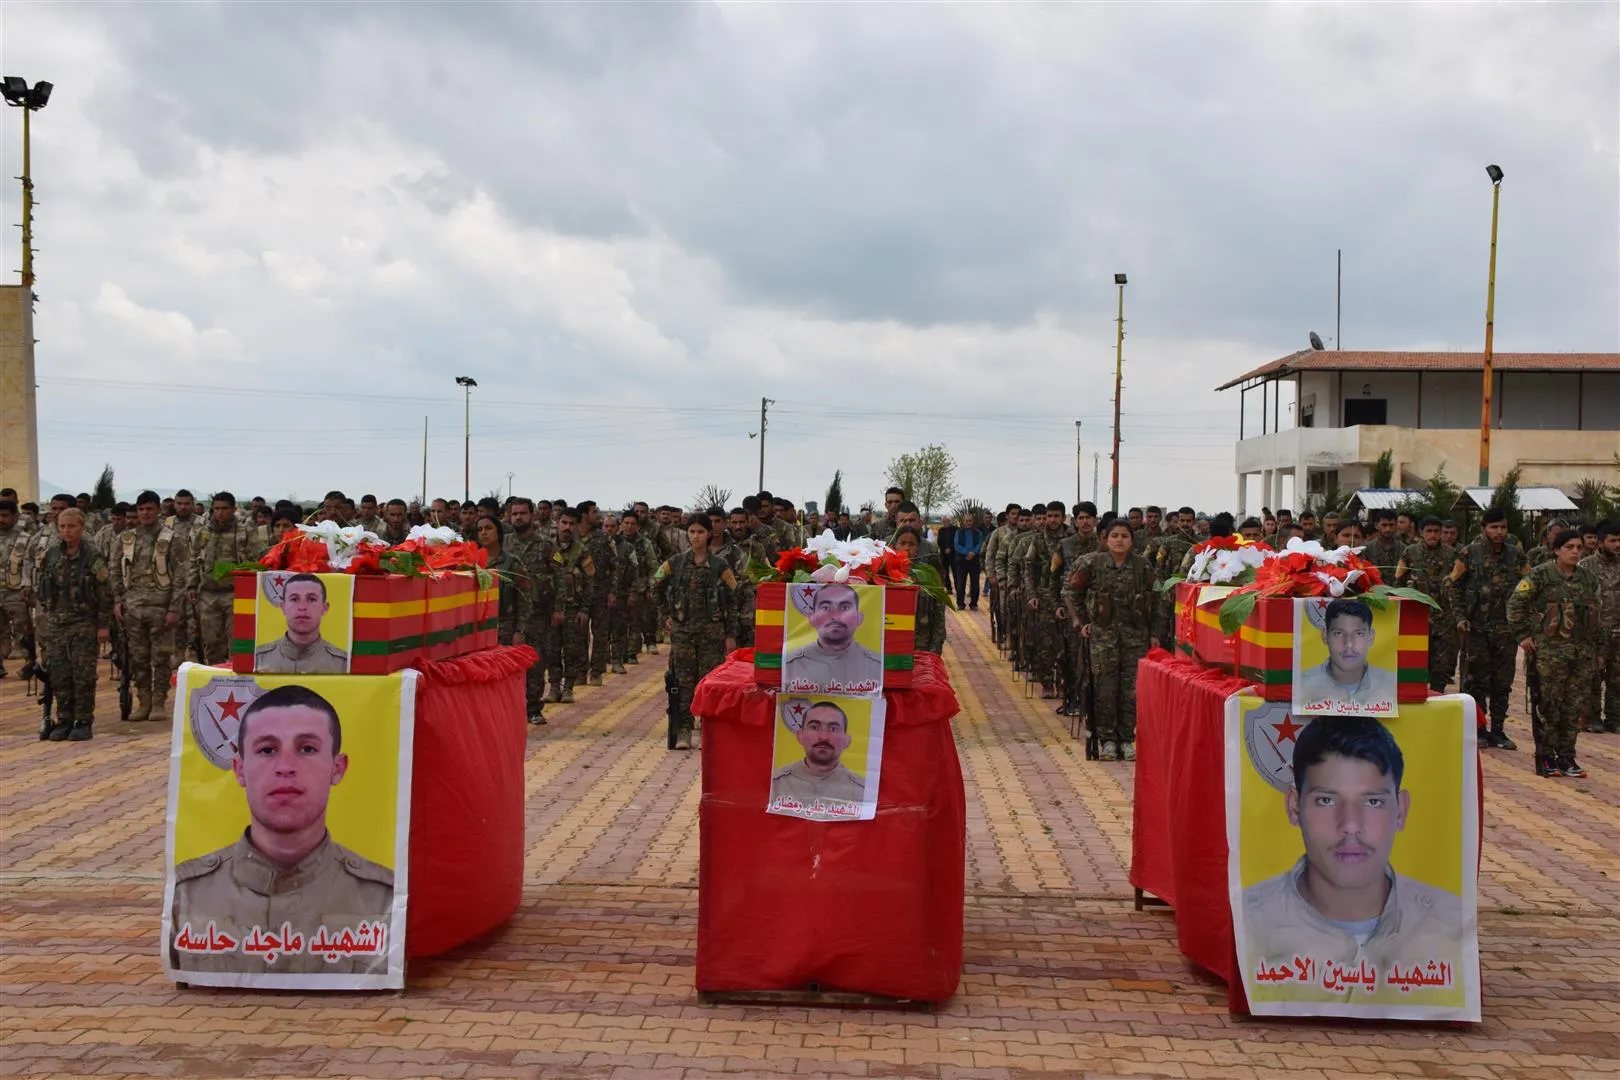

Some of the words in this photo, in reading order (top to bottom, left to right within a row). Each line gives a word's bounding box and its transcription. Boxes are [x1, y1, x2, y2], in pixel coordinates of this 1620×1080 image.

[1363, 700, 1393, 714] الشهيد
[245, 922, 303, 961] ماجد
[310, 922, 385, 960] الشهيد
[1255, 956, 1316, 982] الاحمد
[1322, 958, 1376, 992] ياسين
[1387, 959, 1452, 991] الشهيد
